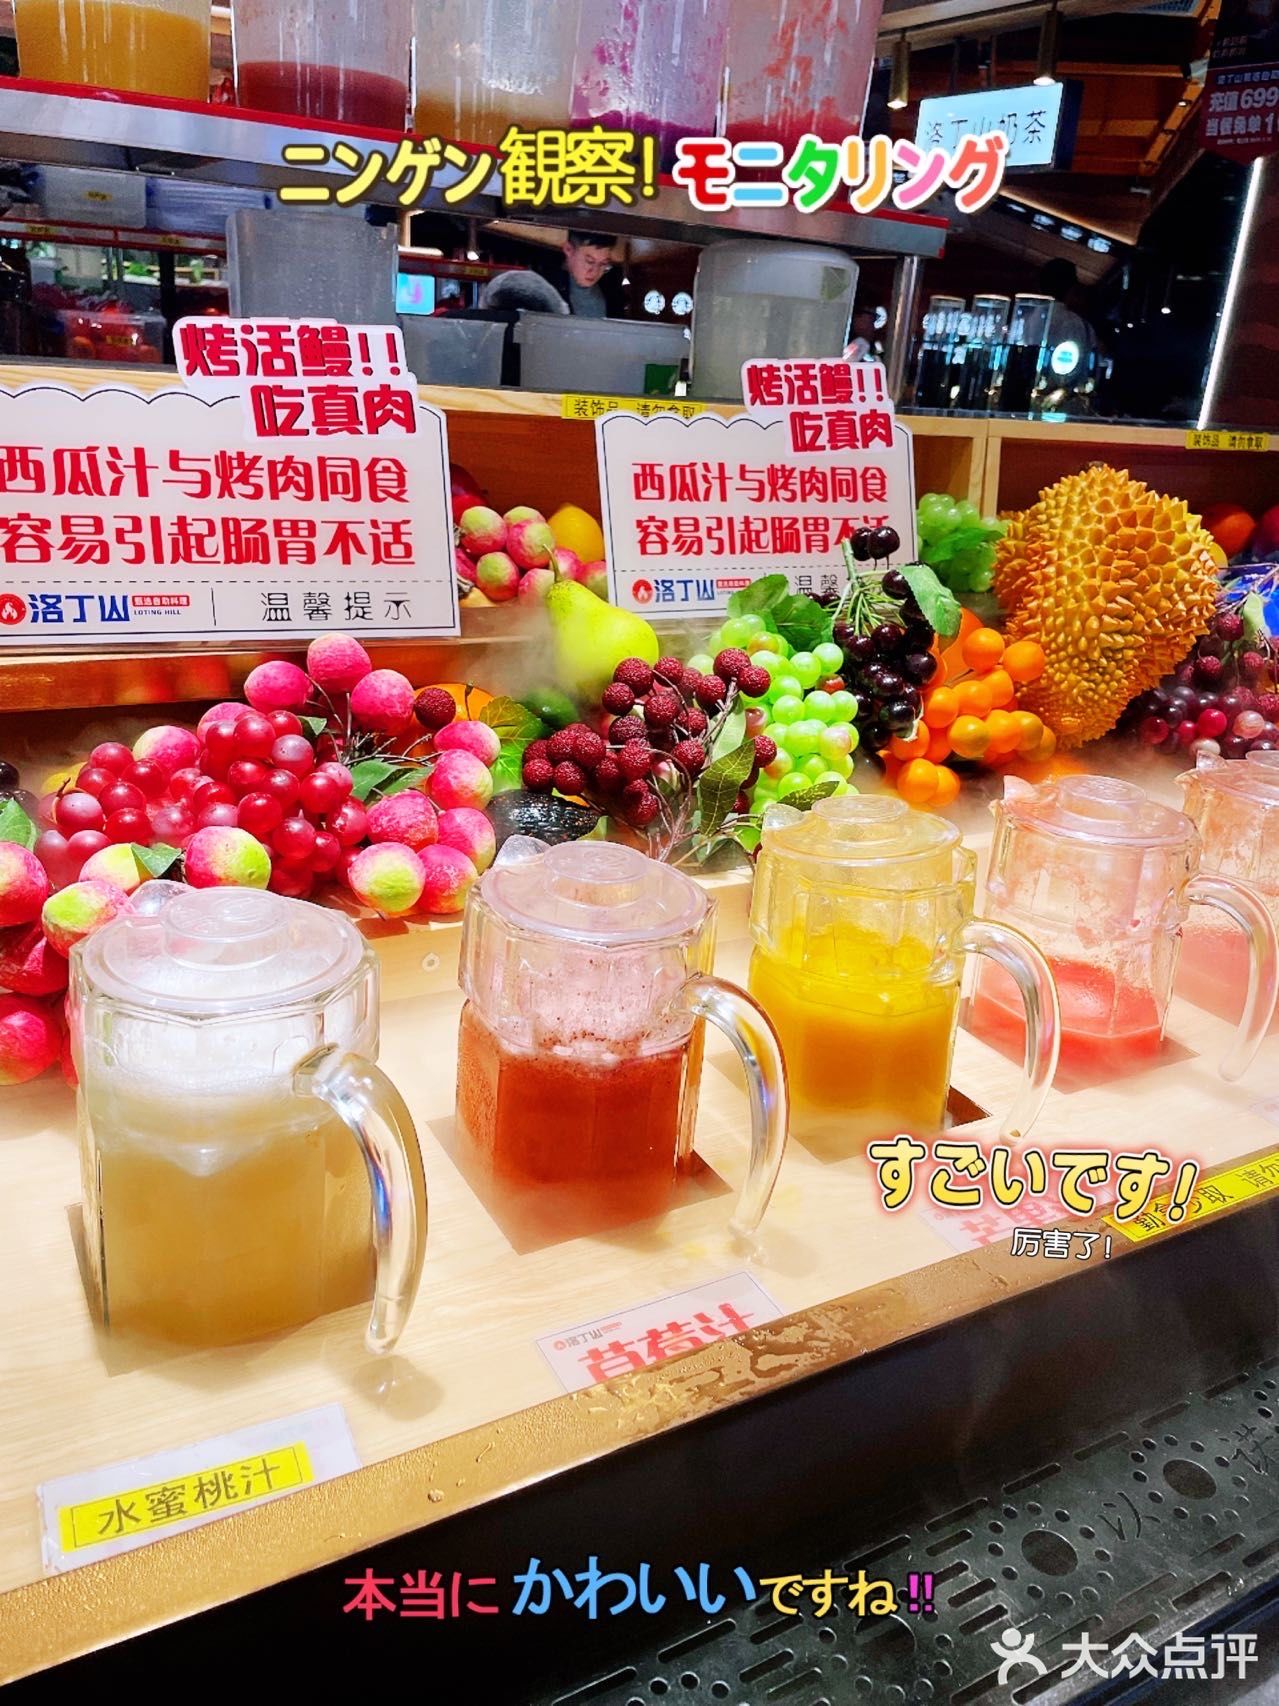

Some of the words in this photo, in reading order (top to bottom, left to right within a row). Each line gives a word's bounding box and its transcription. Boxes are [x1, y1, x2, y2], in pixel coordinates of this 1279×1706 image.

[1205, 112, 1279, 136] 当餐免单1
[179, 323, 402, 379] 烤活鳗!!
[745, 362, 884, 406] 烤活鳗!!
[250, 384, 417, 437] 吃真肉
[789, 408, 893, 452] 吃真肉
[0, 445, 409, 503] 西瓜汁与烤肉同食
[632, 462, 888, 503] 西瓜汁与烤肉同食
[0, 512, 416, 567] 容易引起肠胃不适
[28, 594, 130, 623] 洛丁山
[164, 608, 182, 616] HILL
[260, 591, 412, 623] 温馨提示
[653, 578, 715, 603] 洛丁山
[97, 1457, 281, 1535] 水蜜桃汁
